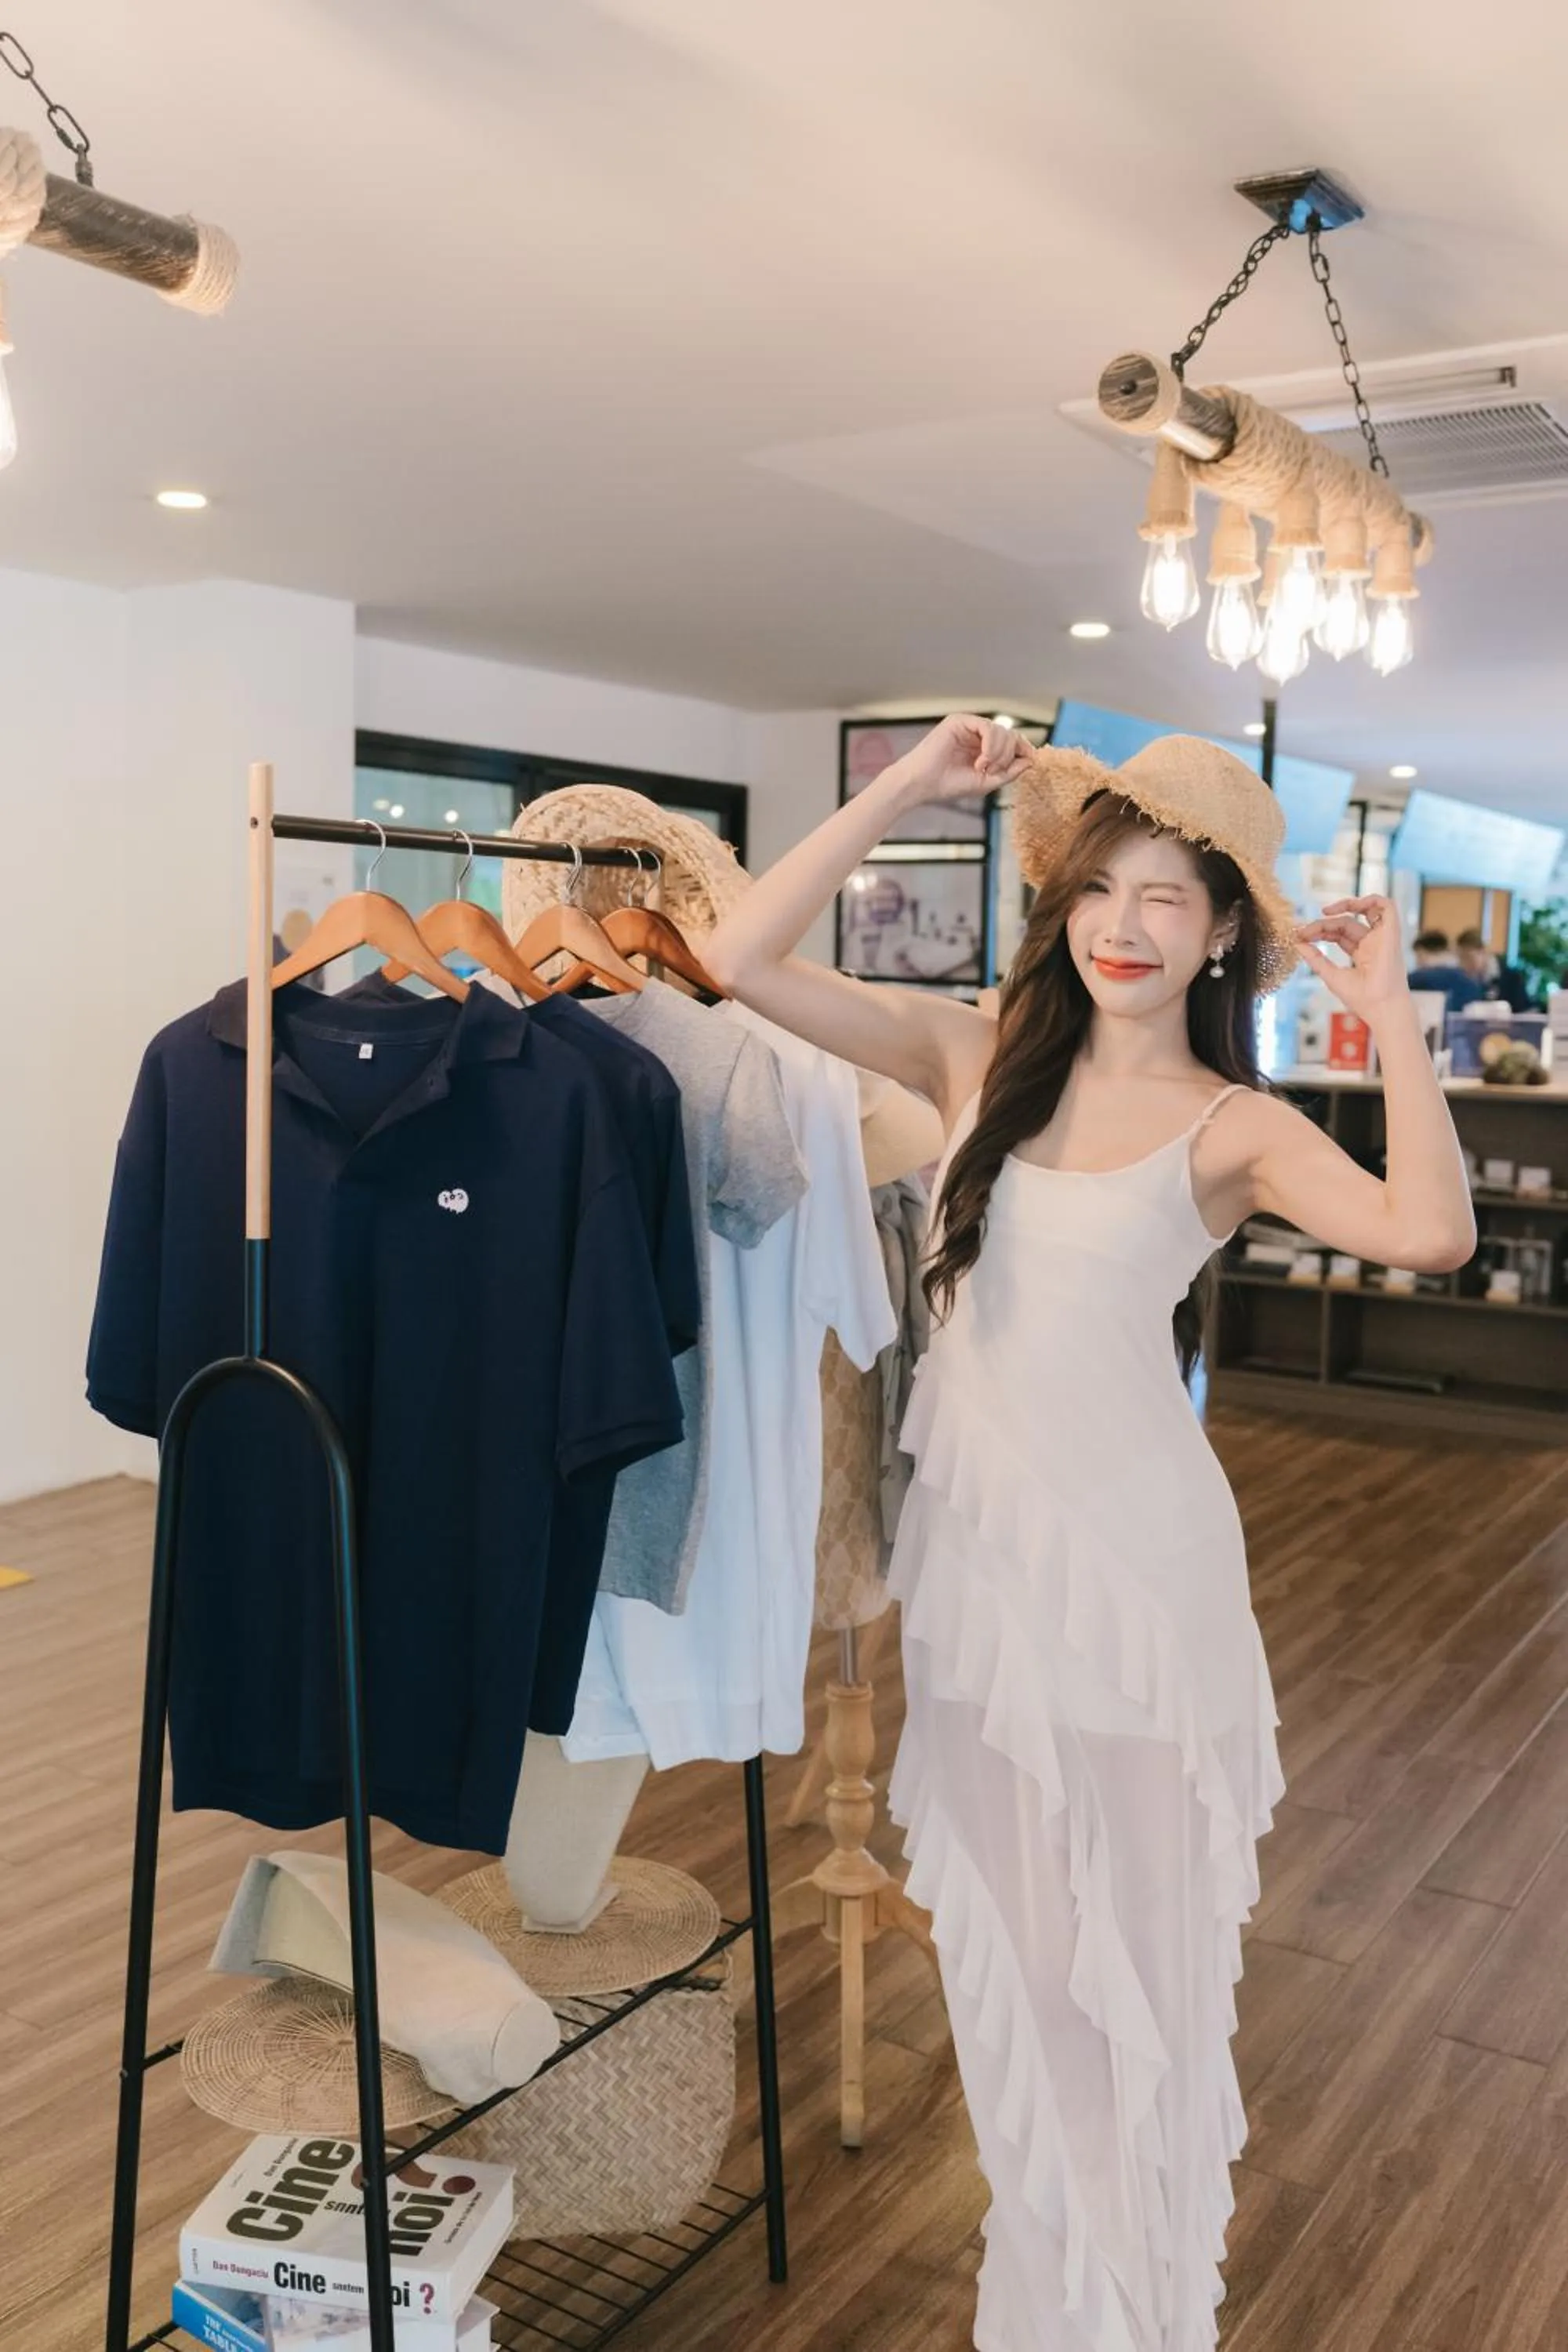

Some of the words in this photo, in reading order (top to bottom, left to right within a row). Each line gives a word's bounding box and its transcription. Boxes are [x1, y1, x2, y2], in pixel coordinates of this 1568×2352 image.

[226, 2140, 355, 2241] Cine
[274, 2262, 326, 2294] Cine
[390, 2281, 410, 2307] oi
[419, 2282, 435, 2314] ?
